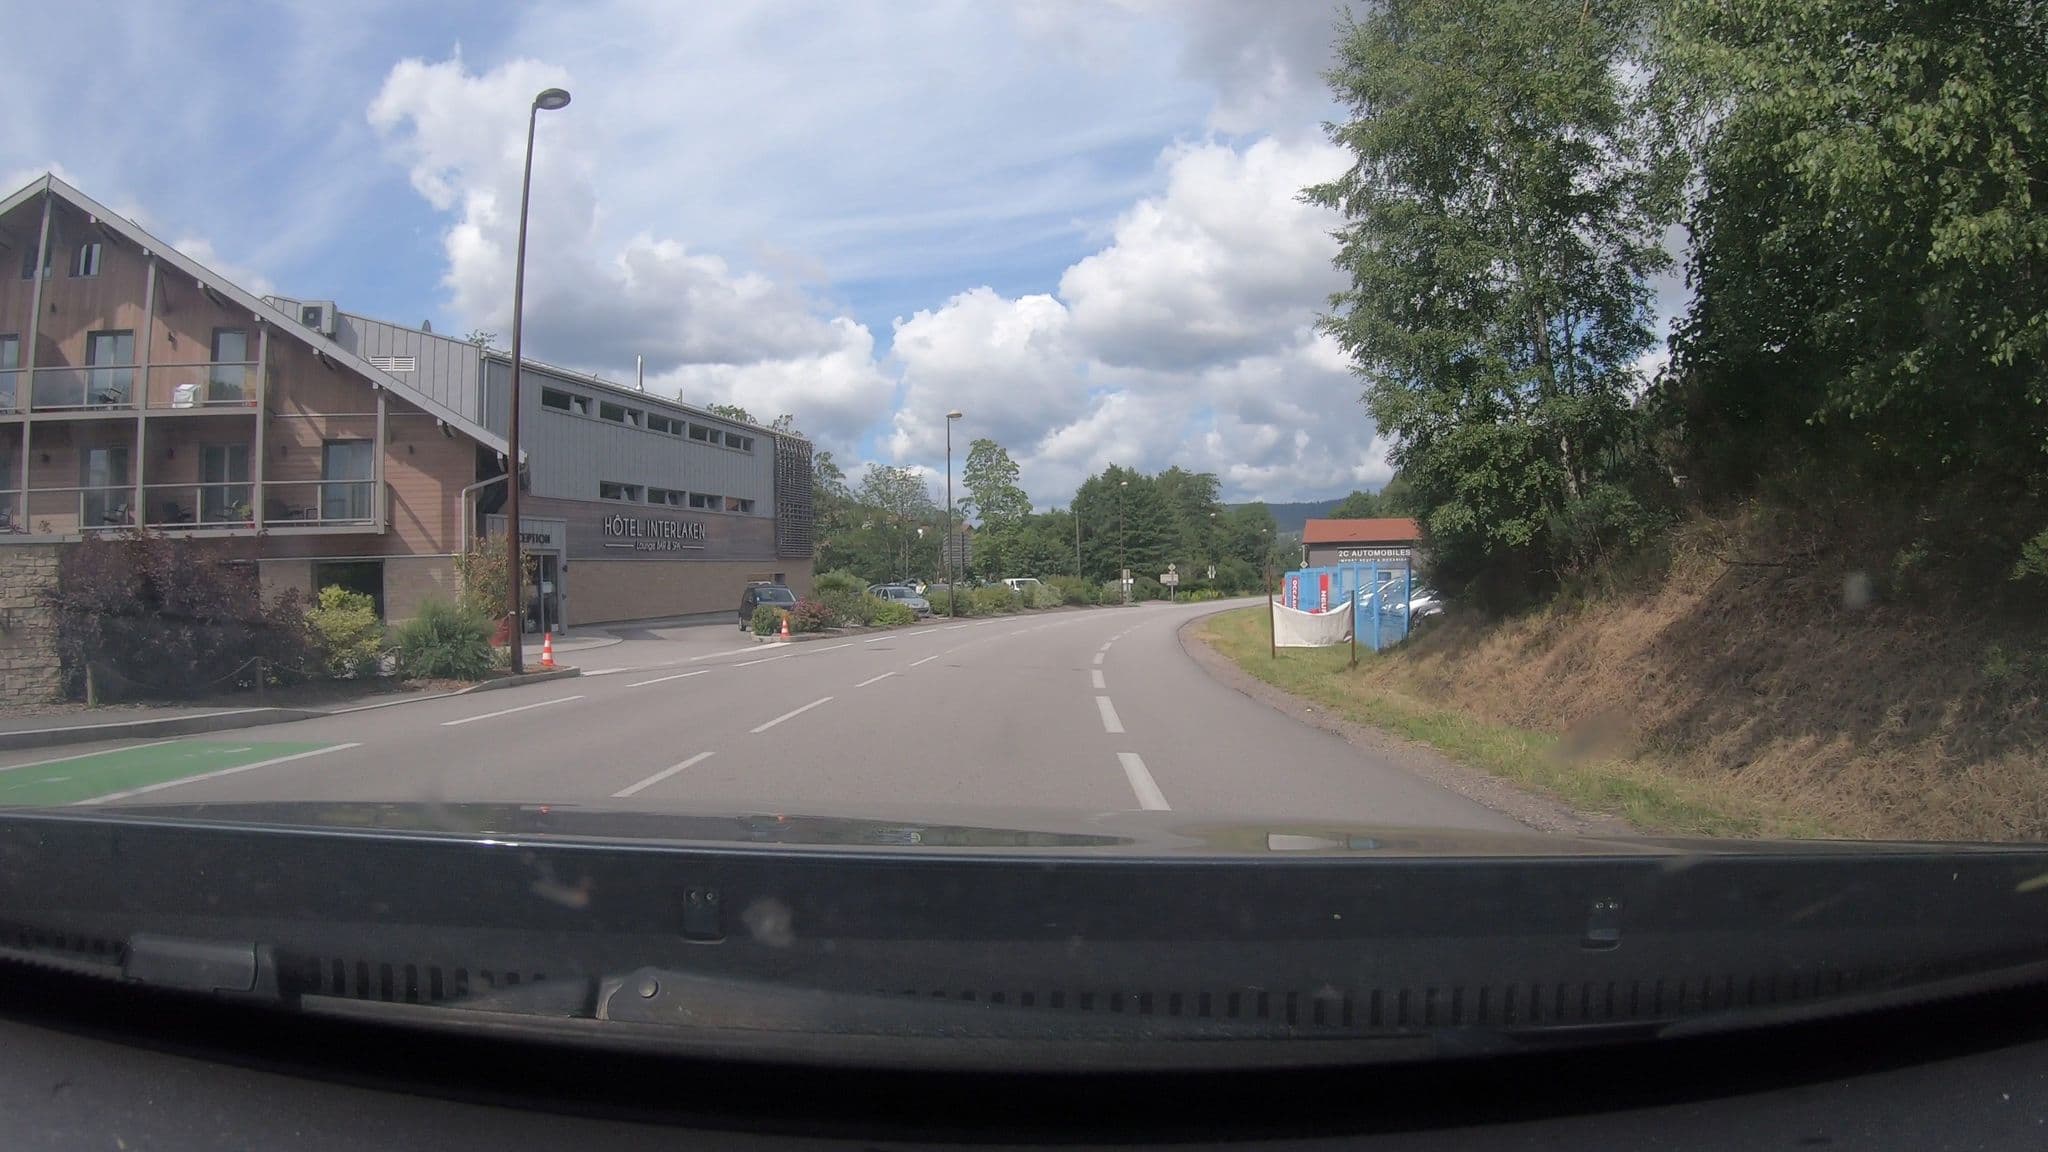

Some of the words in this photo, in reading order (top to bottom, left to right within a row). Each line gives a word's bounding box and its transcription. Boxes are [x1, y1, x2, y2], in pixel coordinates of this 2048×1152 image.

[604, 514, 642, 537] HÔTEL
[647, 519, 705, 540] INTERLAKEN
[1351, 549, 1411, 557] AUTOMOBILES
